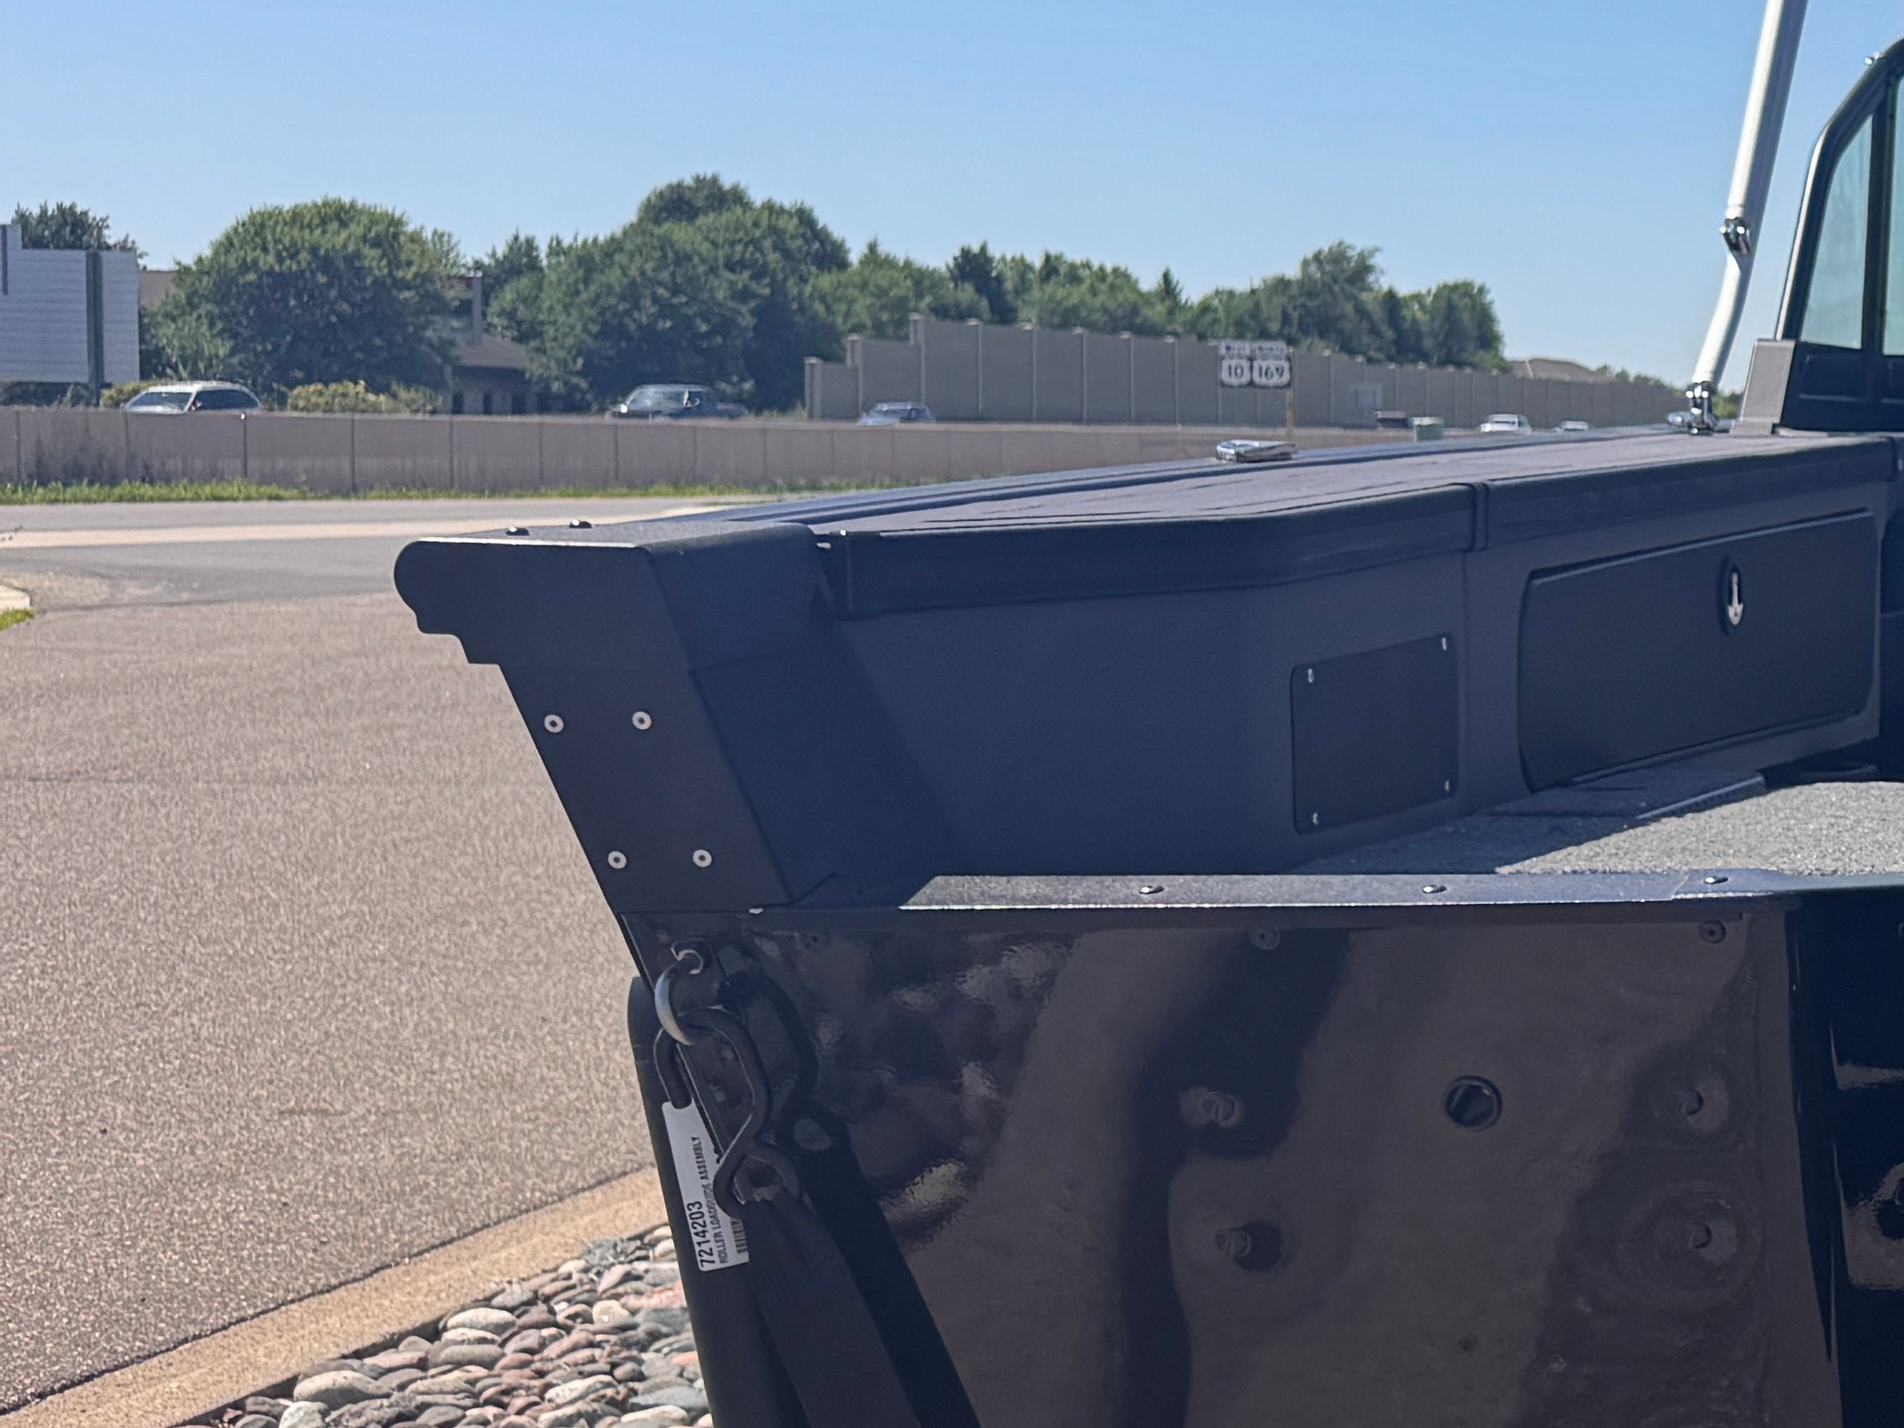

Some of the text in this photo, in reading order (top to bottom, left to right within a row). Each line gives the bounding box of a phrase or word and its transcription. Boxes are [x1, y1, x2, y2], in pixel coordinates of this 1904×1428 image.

[1227, 363, 1244, 380] 10
[1258, 364, 1285, 381] 169
[686, 1200, 716, 1268] 7214203
